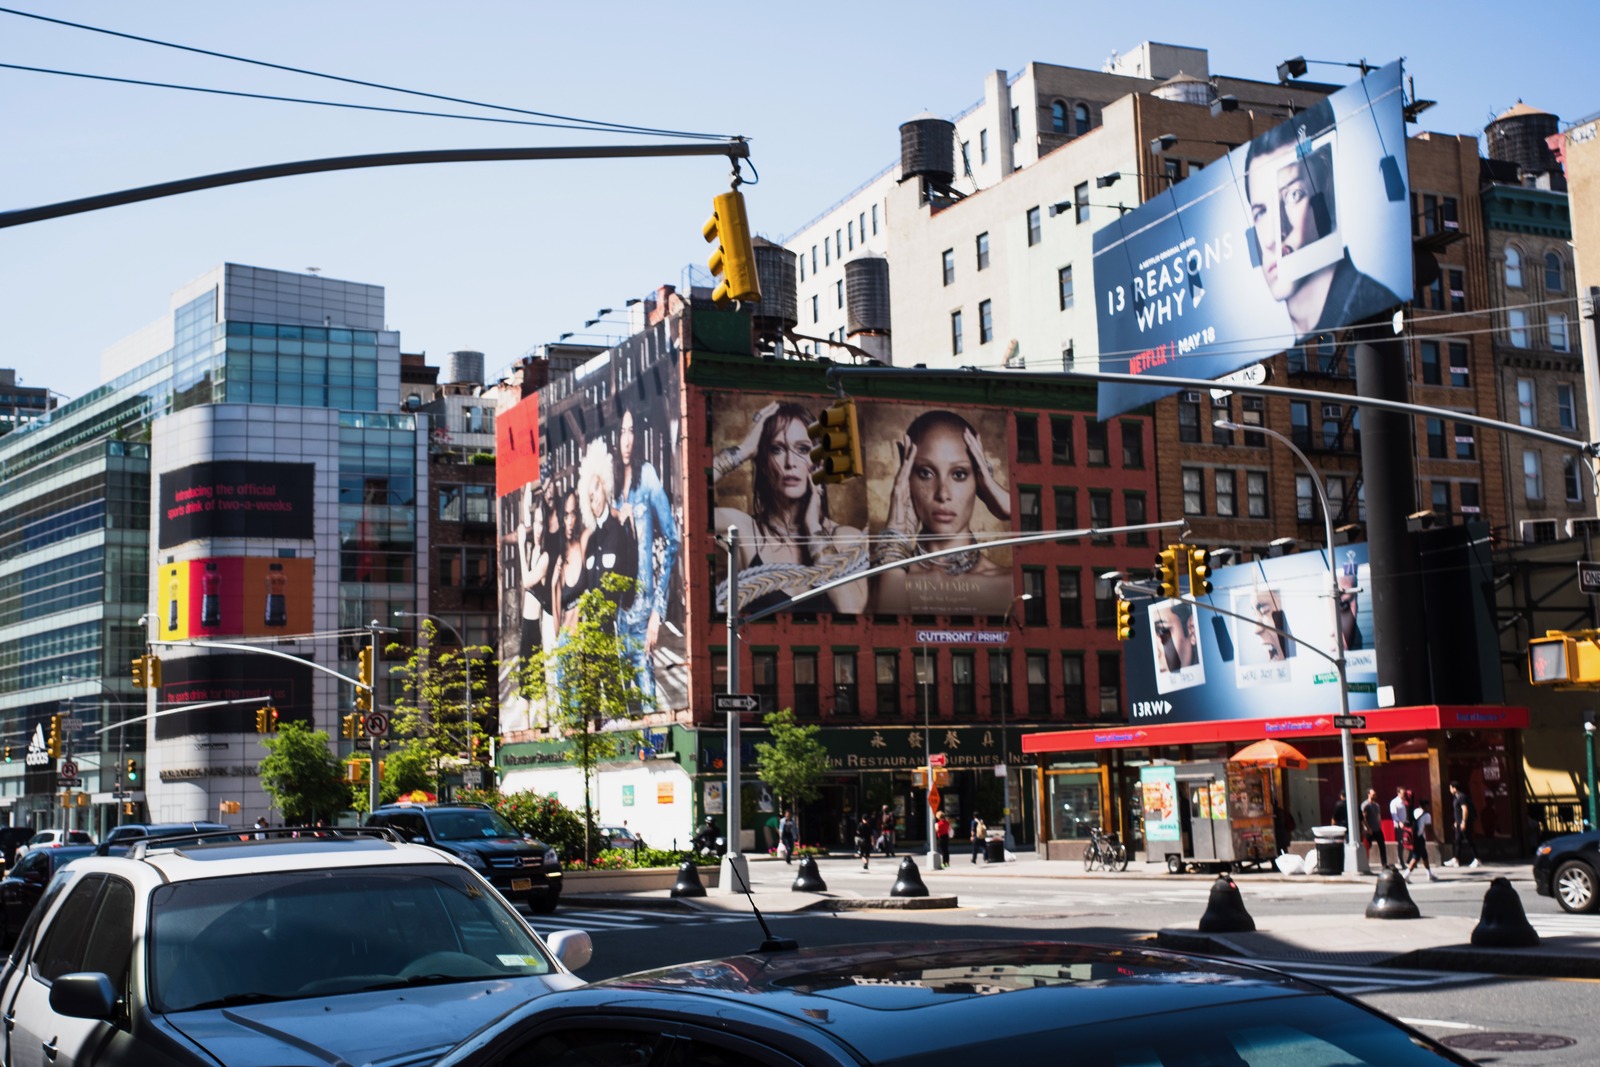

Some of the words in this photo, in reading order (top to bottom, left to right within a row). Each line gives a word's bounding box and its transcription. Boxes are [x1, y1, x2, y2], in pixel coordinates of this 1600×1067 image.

[1108, 285, 1125, 315] 13
[1133, 232, 1233, 302] REASONS
[1136, 288, 1186, 333] WHY
[1129, 343, 1167, 375] NETFLIX
[1178, 332, 1201, 355] MAY
[1201, 326, 1216, 345] 18
[175, 485, 213, 502] introducing
[216, 484, 235, 495] the
[237, 484, 276, 496] official
[185, 500, 204, 515] drink
[204, 499, 215, 511] of
[218, 499, 293, 512] two-a-weeks
[847, 754, 925, 766] RESTAURAN
